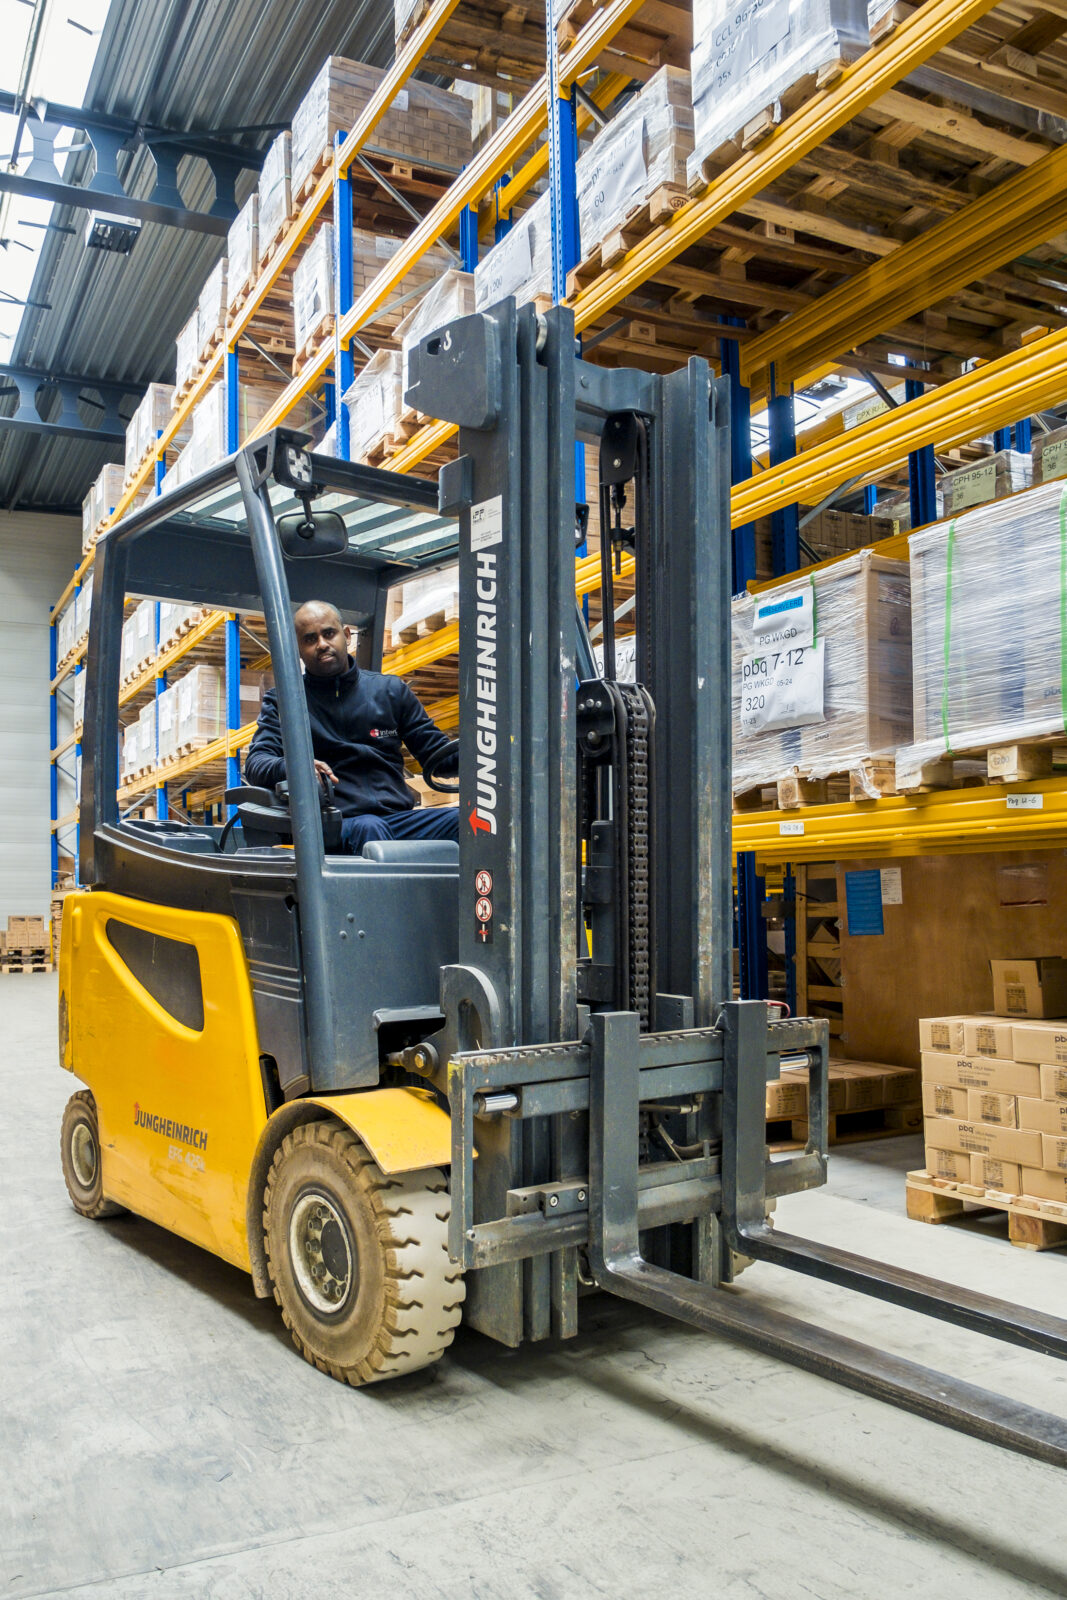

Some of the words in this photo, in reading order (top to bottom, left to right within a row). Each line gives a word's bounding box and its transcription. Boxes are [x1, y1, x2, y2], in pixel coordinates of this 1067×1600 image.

[715, 24, 733, 47] CCL
[594, 190, 605, 208] 60
[1043, 443, 1062, 457] CPH
[953, 475, 970, 486] CPH
[971, 467, 993, 481] 95-12
[759, 635, 771, 645] PG
[743, 660, 768, 681] pbq
[771, 648, 804, 671] 7-12
[754, 677, 775, 689] WKGD
[476, 552, 497, 836] JUNGHEINRICH
[745, 695, 765, 711] 320
[957, 1061, 973, 1069] pbq
[133, 1108, 208, 1151] JUNGHEINRICH
[958, 1124, 974, 1134] pbq
